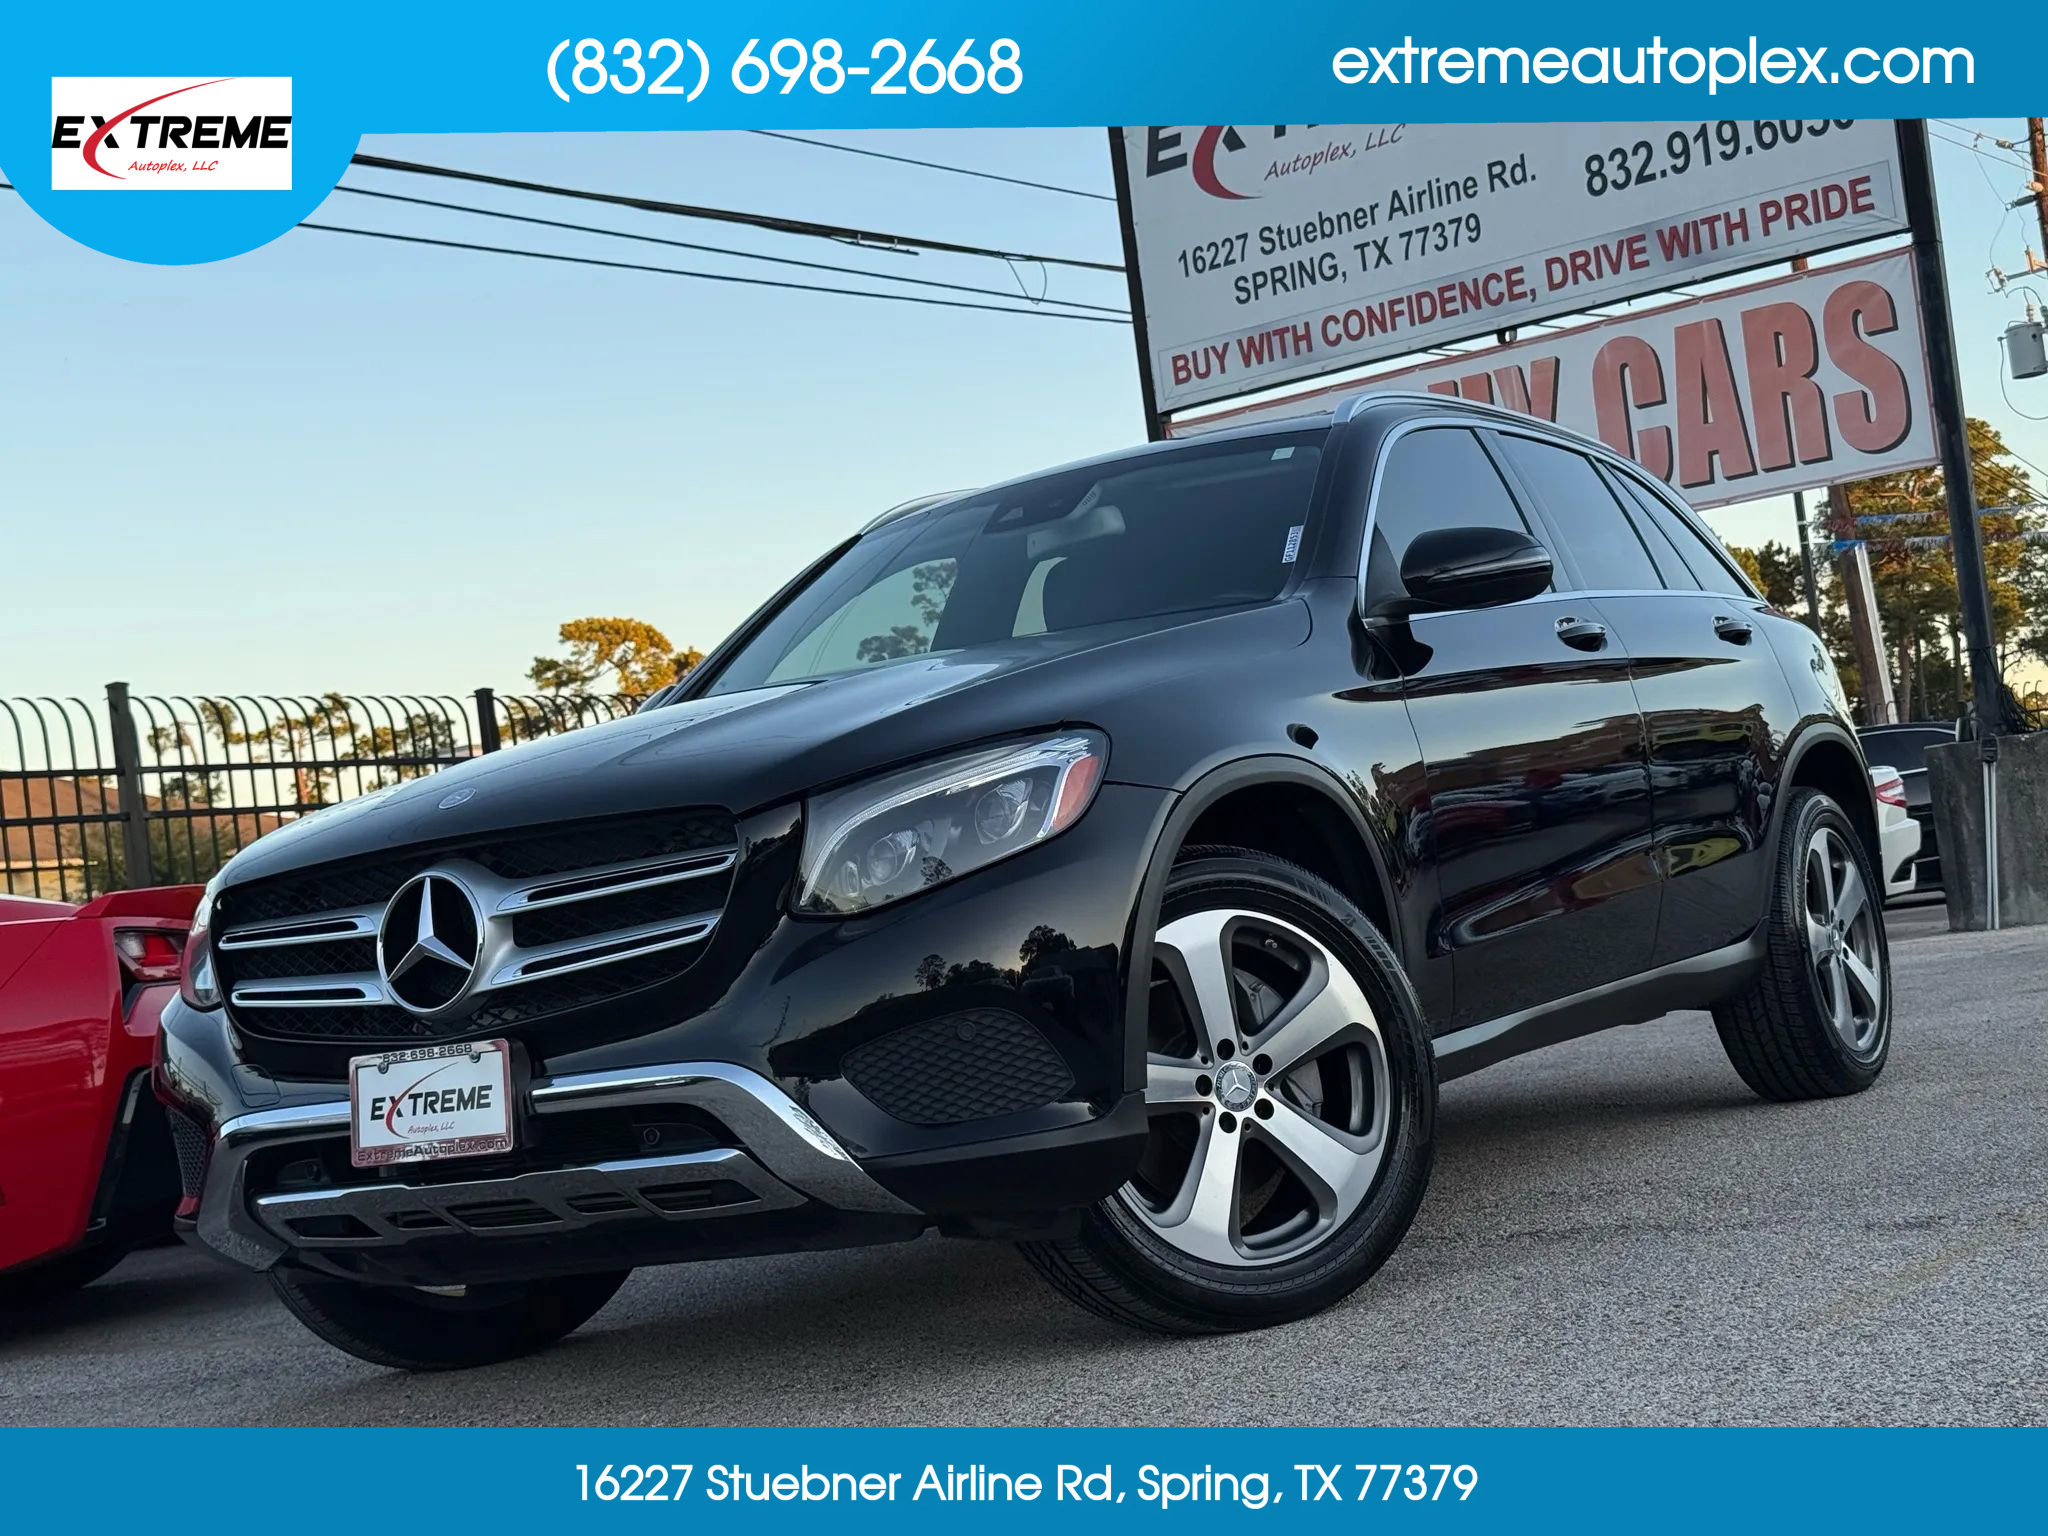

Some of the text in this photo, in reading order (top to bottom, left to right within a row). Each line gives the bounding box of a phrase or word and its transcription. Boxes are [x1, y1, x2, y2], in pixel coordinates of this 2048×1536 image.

[1264, 141, 1357, 181] Autoplex,
[1364, 123, 1405, 151] LLC
[1585, 119, 1855, 197] 832.919.60
[1178, 153, 1537, 278] 16227 Stuebner Airline Rd.
[1171, 175, 1875, 386] BUY WITH CONFIDENCE, DRIVE WITH PRIDE
[1233, 212, 1482, 305] SPRING, TX 77379
[1592, 280, 1912, 489] CARS
[370, 1084, 493, 1121] EXTREME
[440, 1120, 456, 1131] LLC
[357, 1137, 508, 1162] ExtremeAutoplex.com
